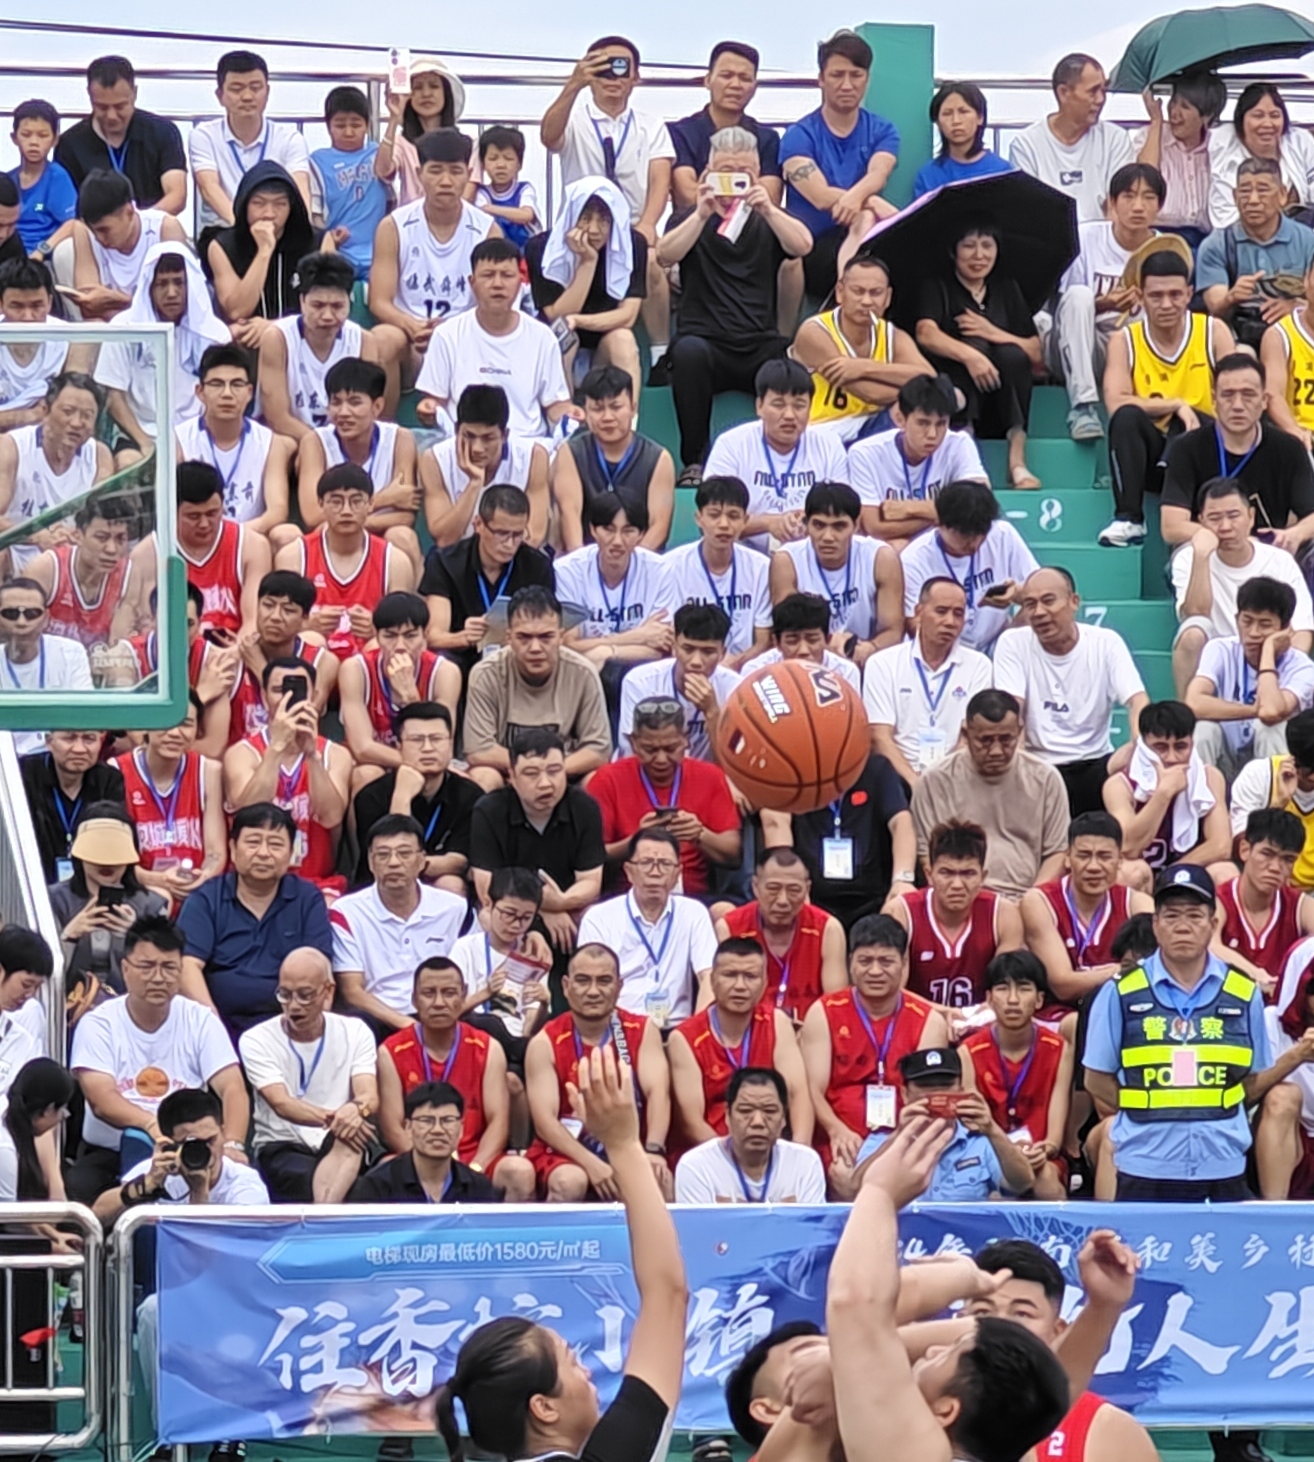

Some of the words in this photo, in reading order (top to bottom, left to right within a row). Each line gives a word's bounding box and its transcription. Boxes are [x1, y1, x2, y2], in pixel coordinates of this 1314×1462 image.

[1043, 701, 1070, 713] FILA
[929, 976, 973, 1008] 16
[1143, 1016, 1224, 1041] 警察
[1143, 1066, 1227, 1087] POCE
